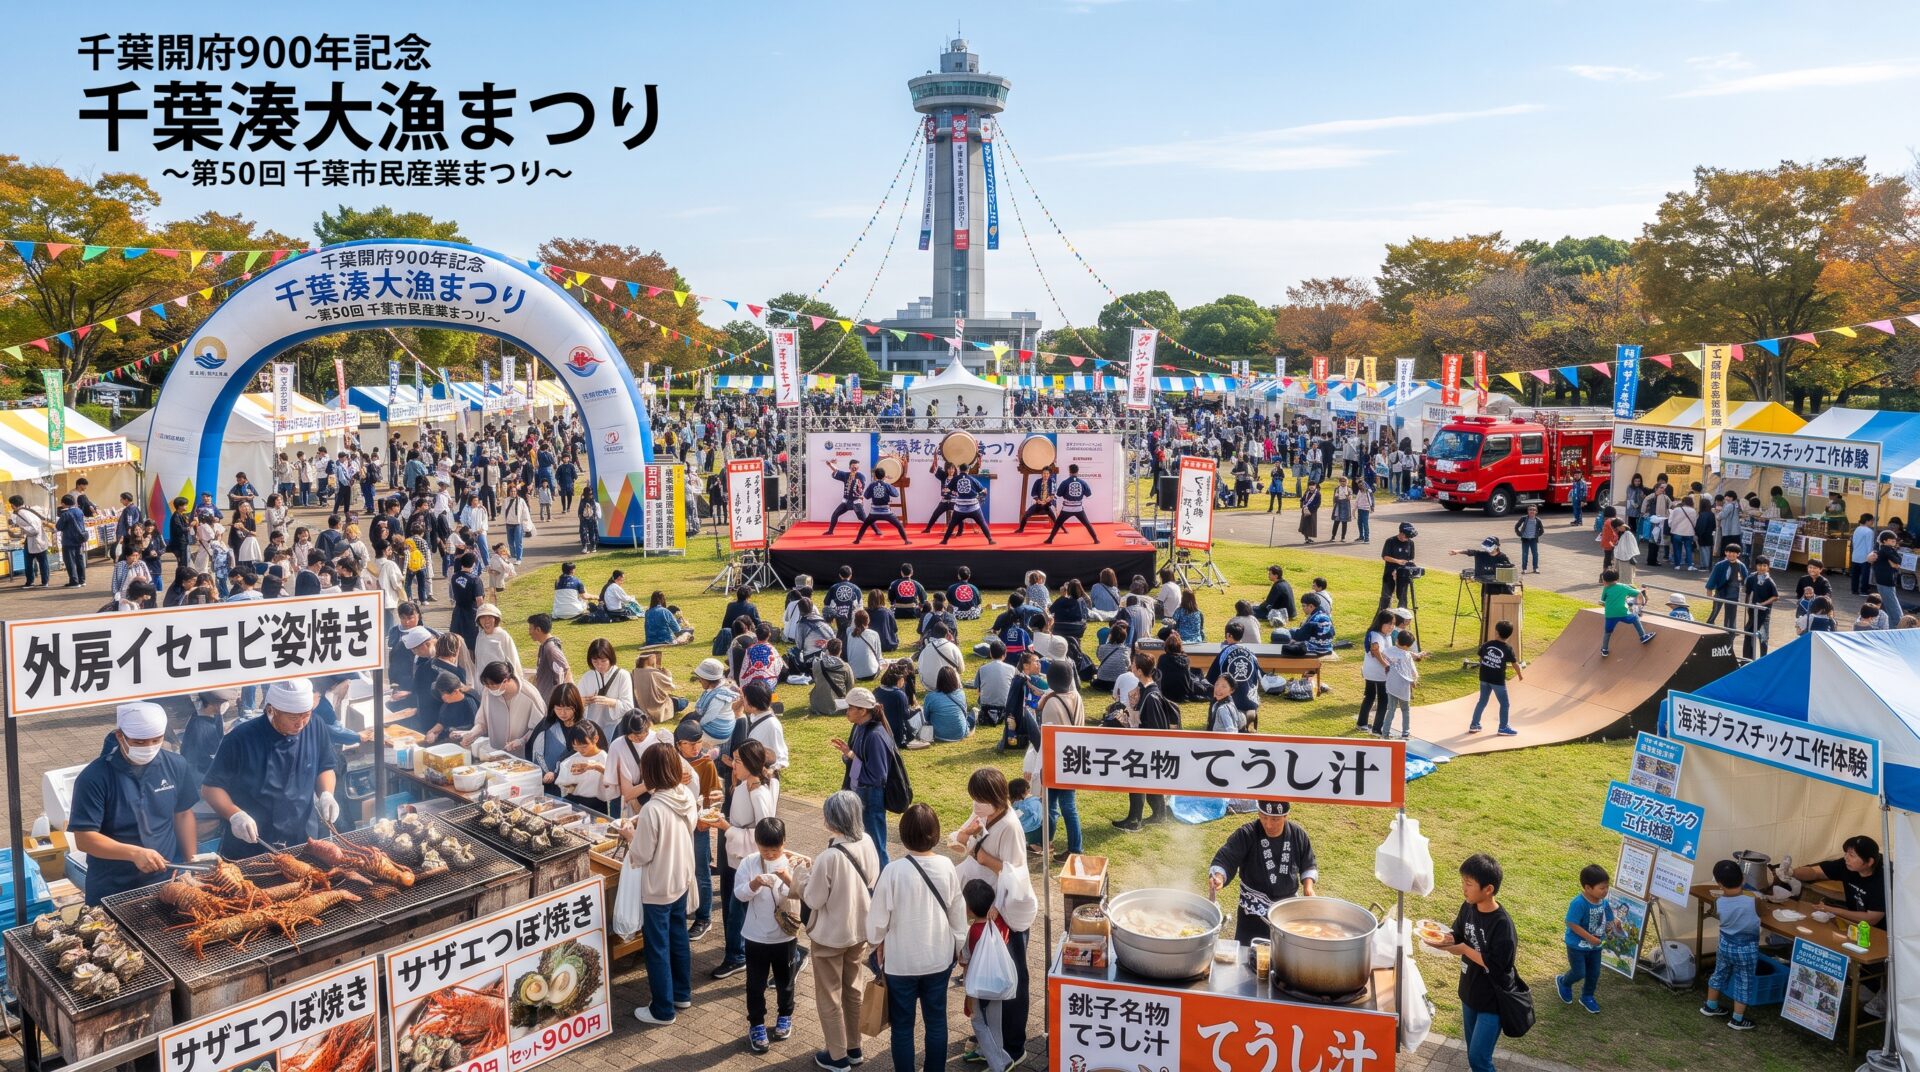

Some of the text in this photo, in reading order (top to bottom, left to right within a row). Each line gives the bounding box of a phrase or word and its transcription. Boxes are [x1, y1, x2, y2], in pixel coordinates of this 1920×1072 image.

[320, 249, 486, 273] 千葉開府900年記念
[274, 268, 526, 314] 千葉湊大漁まつり
[1622, 428, 1694, 452] 県産野菜販売
[1727, 435, 1869, 470] 海洋プラスチック工作体験
[23, 605, 373, 699] 外房イセエビ姿焼き
[1677, 703, 1869, 780] 海洋プラスチック工作体験
[1062, 745, 1379, 796] 銚子名物 てうし汁
[397, 894, 594, 992] サザエつぼ焼き
[171, 975, 368, 1072] サザエつぼ焼き
[1068, 992, 1170, 1027] 銚子名物
[509, 1014, 600, 1065] セット900円
[1069, 1023, 1170, 1057] てうし汁
[1197, 1020, 1377, 1072] てうし汁
